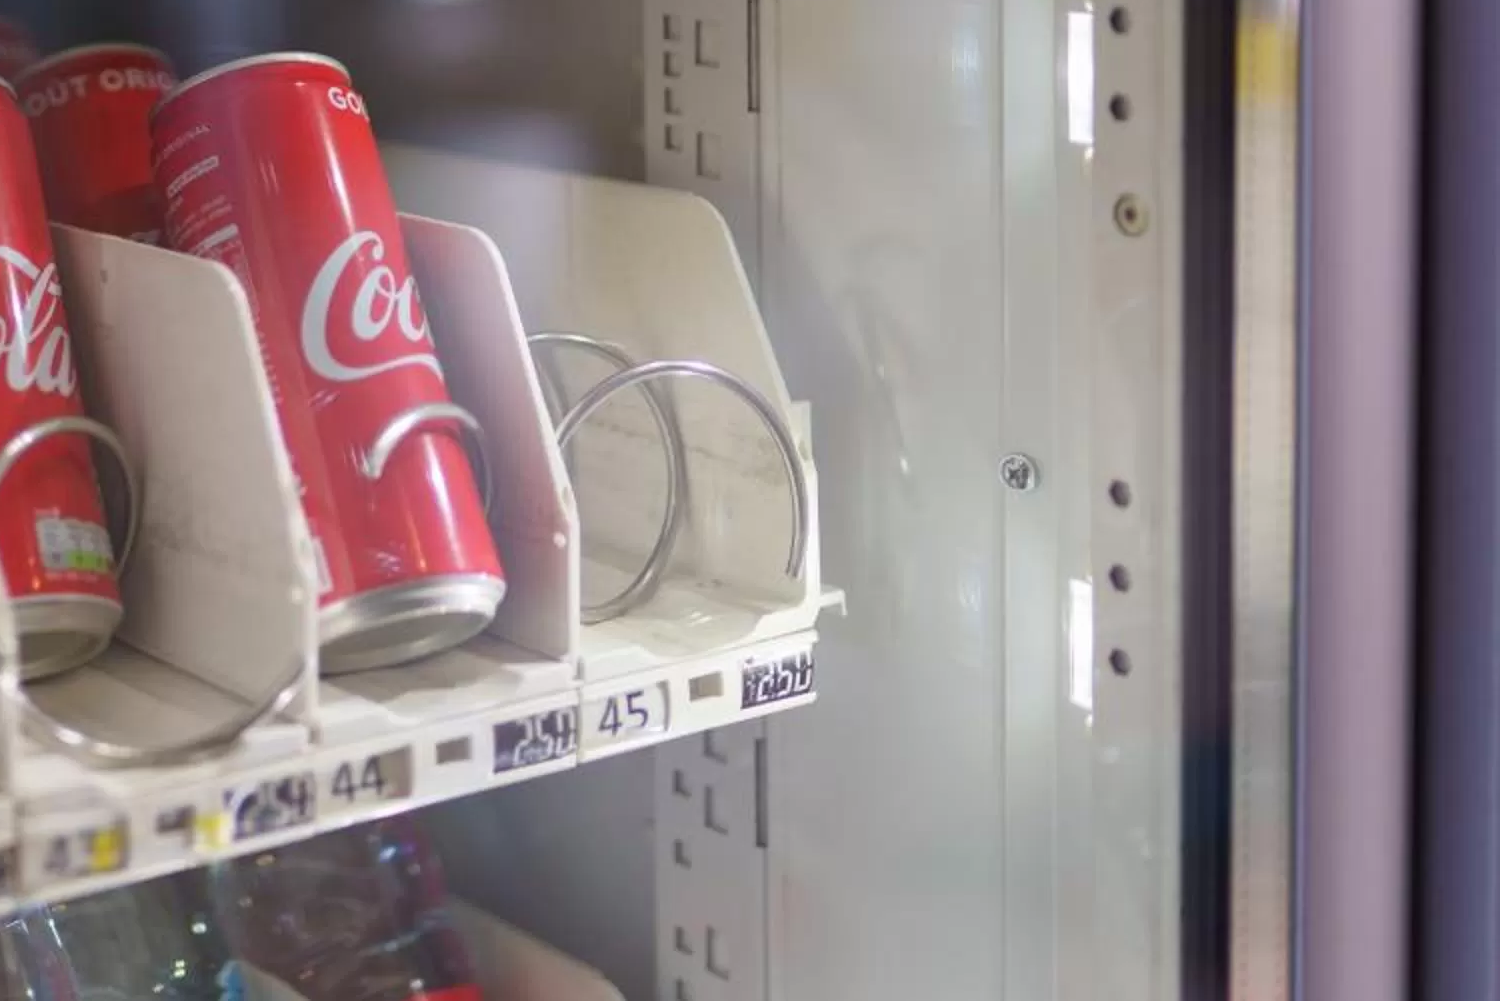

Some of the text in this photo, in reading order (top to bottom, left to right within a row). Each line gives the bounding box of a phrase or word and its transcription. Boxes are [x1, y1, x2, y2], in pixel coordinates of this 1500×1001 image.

[328, 86, 370, 122] GO
[302, 230, 445, 383] Coc
[598, 690, 649, 736] 45
[330, 755, 387, 803] 44
